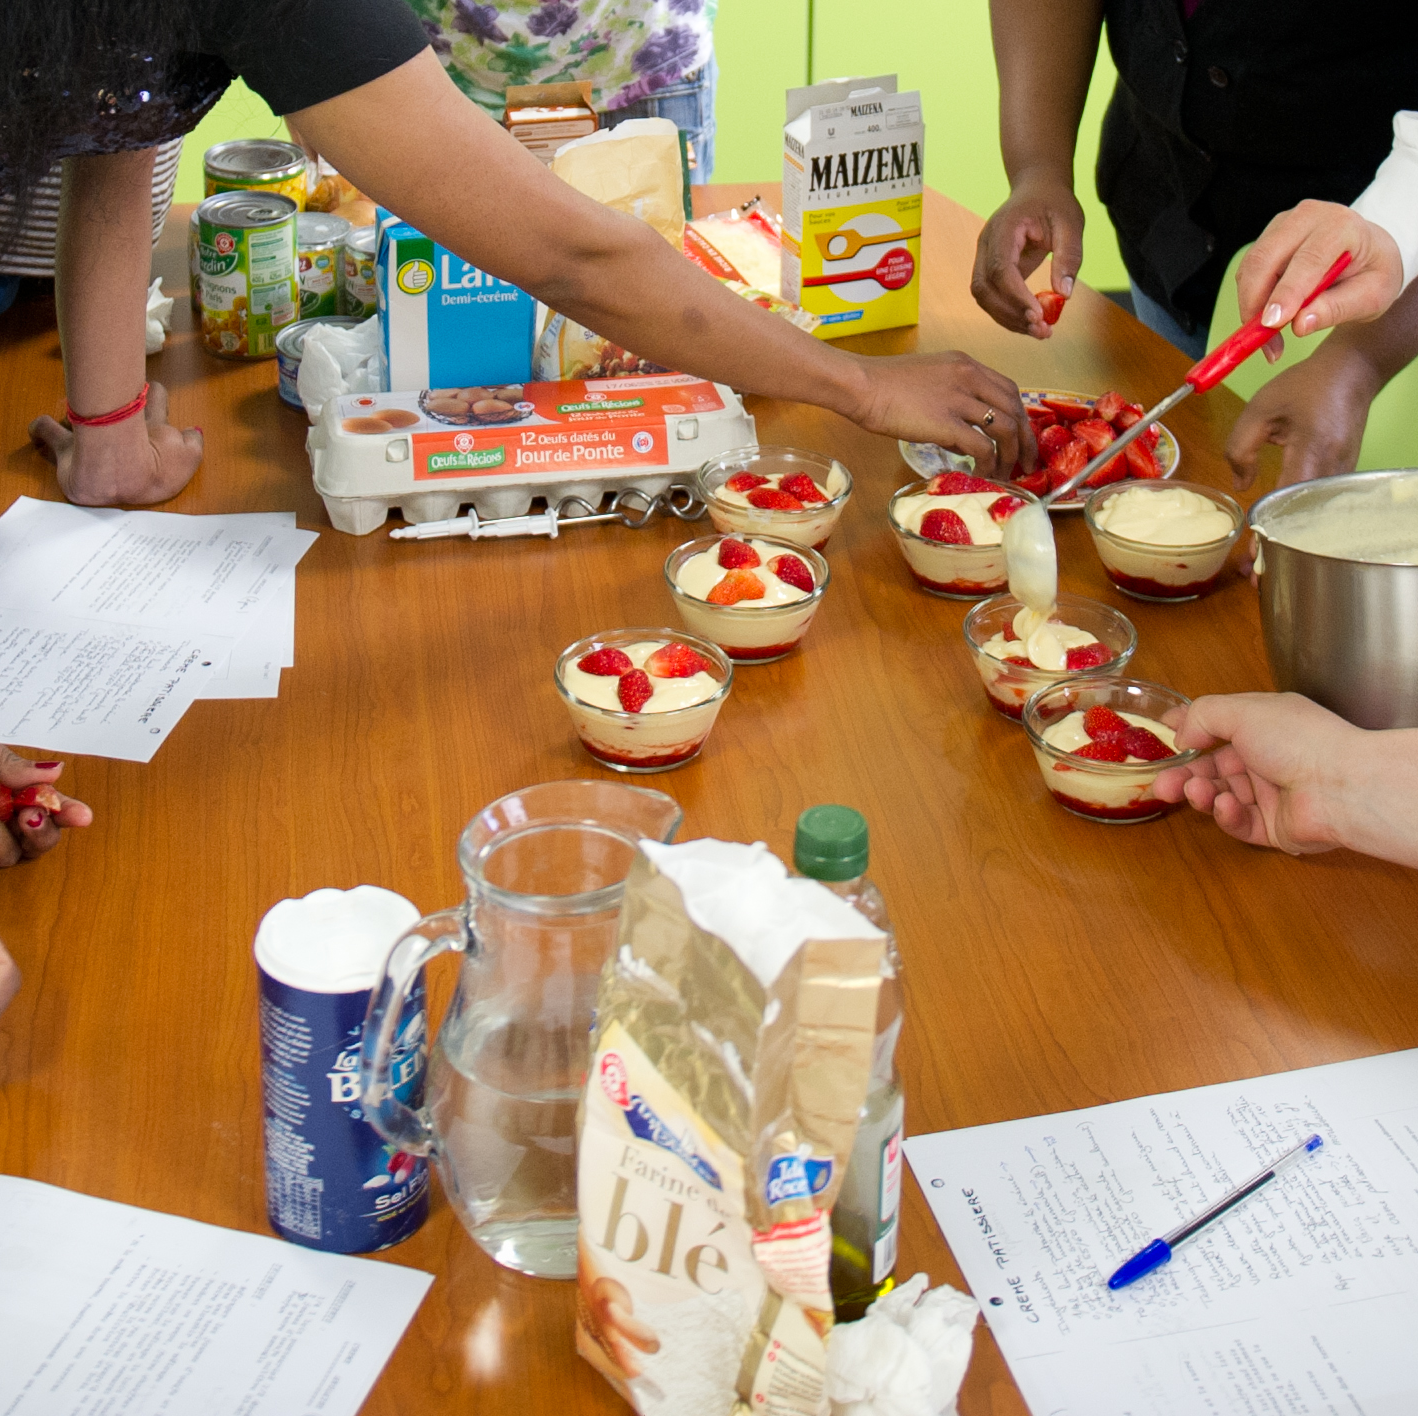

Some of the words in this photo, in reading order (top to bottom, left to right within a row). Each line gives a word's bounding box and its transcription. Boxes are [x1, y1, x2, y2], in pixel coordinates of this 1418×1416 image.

[850, 101, 883, 118] MAIZENA
[785, 131, 805, 159] MAIZENA
[809, 141, 921, 192] MAIZENA
[808, 190, 851, 202] FLEUR
[864, 186, 878, 195] DE
[441, 290, 518, 306] Demi-écrémé
[520, 432, 536, 446] 12
[570, 431, 599, 443] datés
[602, 431, 616, 442] du
[467, 451, 502, 466] Régions
[516, 449, 553, 468] Jour
[553, 450, 571, 462] de
[573, 444, 624, 461] Ponte
[618, 1144, 701, 1202] Farine
[375, 1188, 407, 1210] Sel
[596, 1172, 729, 1295] blé
[1007, 1277, 1039, 1323] CREME
